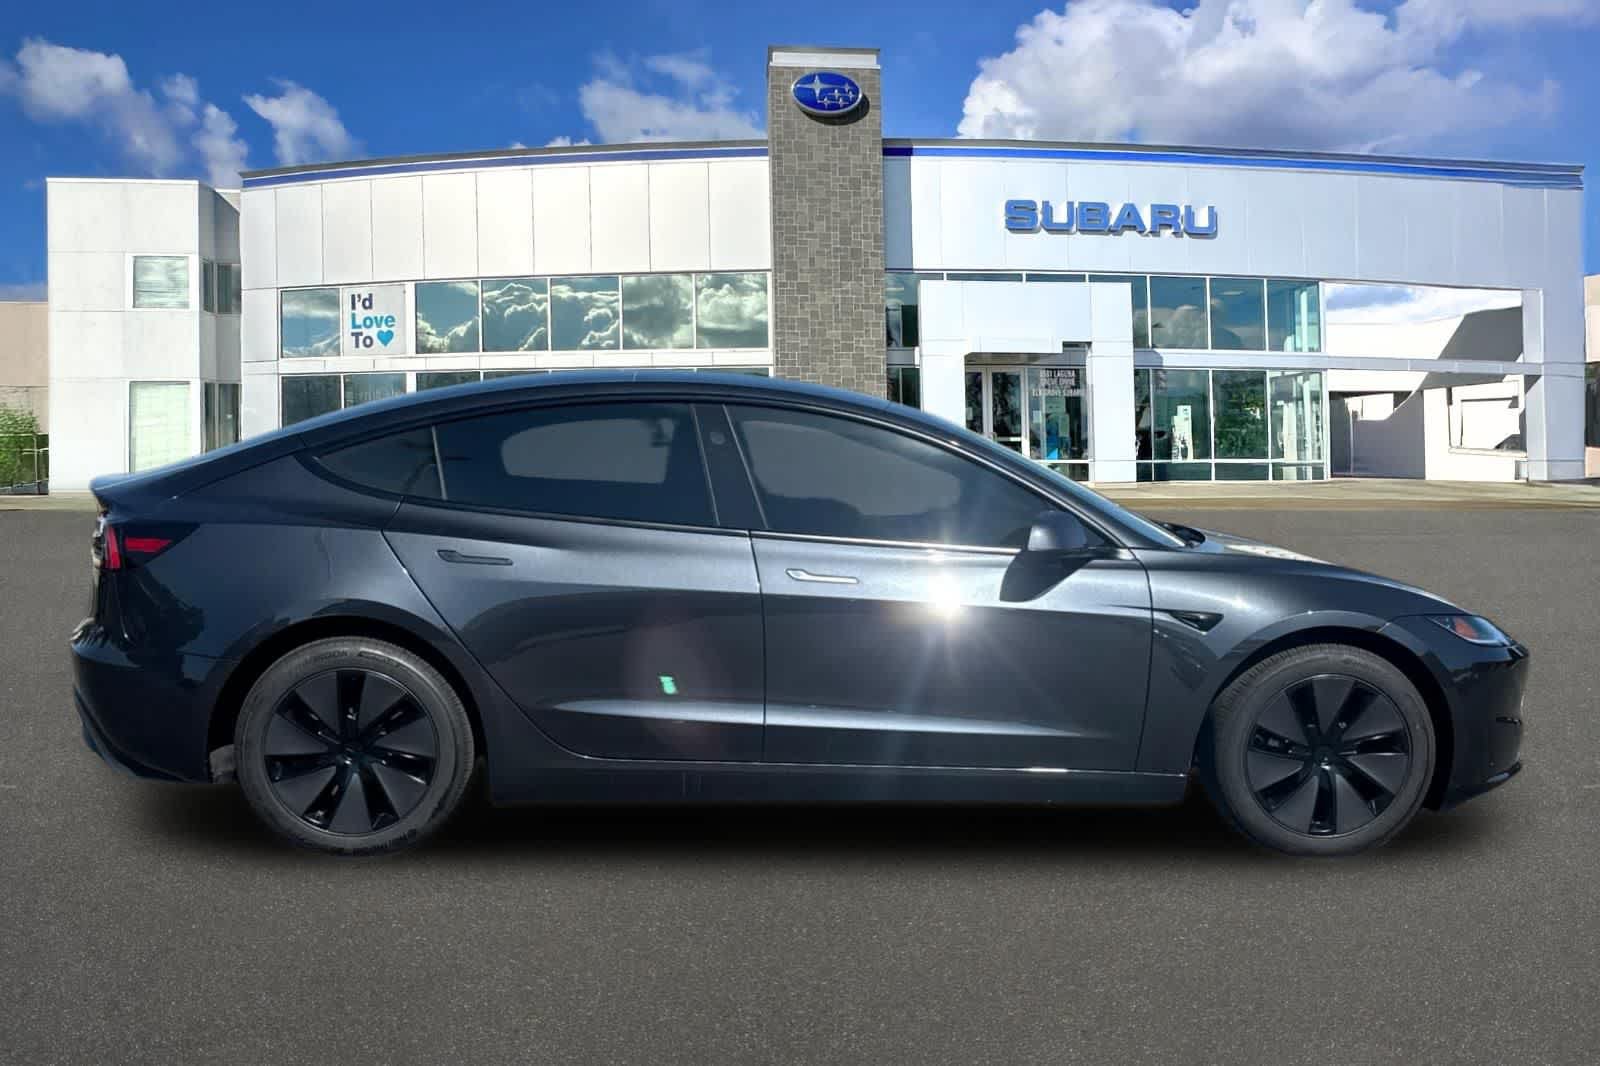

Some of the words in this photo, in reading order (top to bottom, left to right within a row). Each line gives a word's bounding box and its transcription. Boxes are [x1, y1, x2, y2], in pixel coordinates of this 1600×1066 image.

[1005, 200, 1217, 238] SUBARU
[351, 312, 396, 330] Love
[351, 332, 374, 349] To
